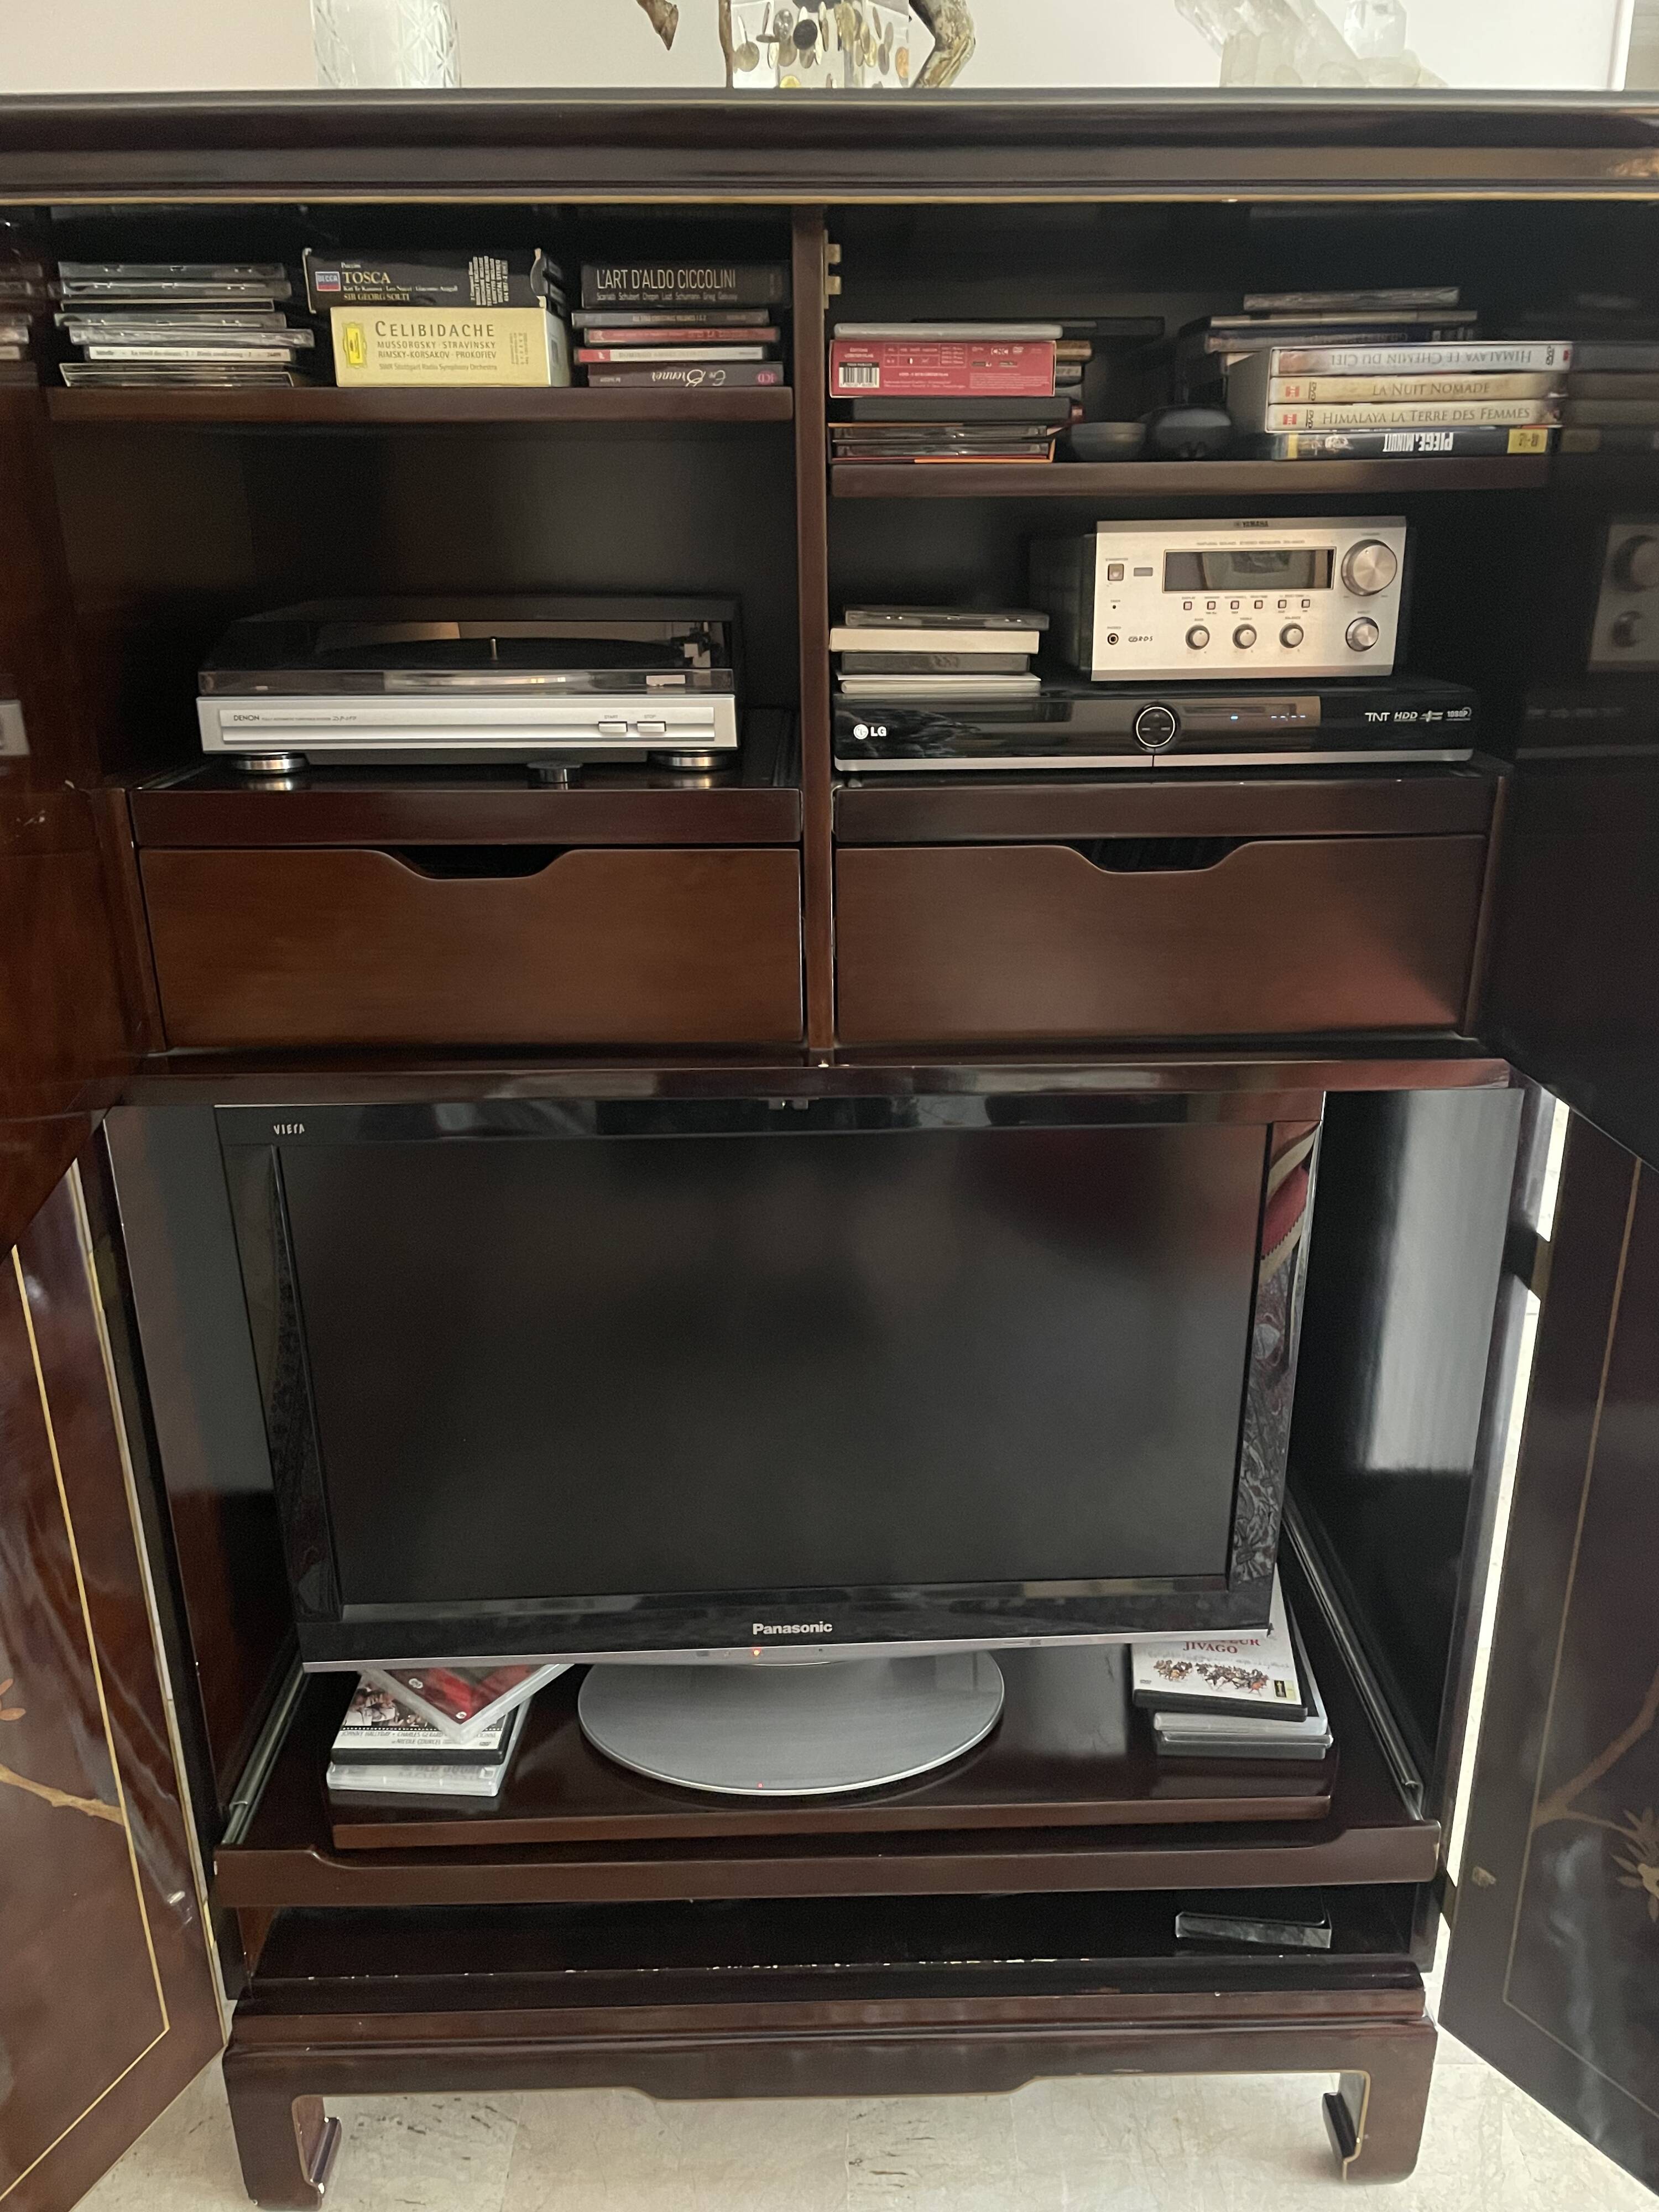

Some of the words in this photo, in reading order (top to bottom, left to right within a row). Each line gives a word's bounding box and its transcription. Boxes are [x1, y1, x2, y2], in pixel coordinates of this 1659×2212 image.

[342, 271, 391, 284] TOSCA
[597, 269, 628, 289] L'ART
[632, 269, 675, 289] D'ALDO
[677, 269, 736, 289] CICCOLINI
[343, 293, 357, 301] SIR
[357, 293, 386, 301] GEORG
[387, 293, 410, 301] SOLTI
[375, 321, 496, 337] CELIBIDACHE
[377, 341, 436, 349] MUSSORGSKY
[443, 341, 497, 349] STRAVINSKY
[378, 351, 450, 359] RIMSKY-KORSAKOV
[456, 350, 497, 359] PROKOFIEV
[1332, 354, 1358, 366] CIEL
[1363, 354, 1381, 364] DU
[1387, 352, 1443, 365] CHEMIN
[1447, 351, 1460, 363] LE
[1466, 350, 1532, 363] HIMALAYA
[394, 363, 421, 372] Stuttgart
[1308, 382, 1317, 401] DVD
[1373, 385, 1386, 396] LA
[1392, 383, 1427, 396] NUIT
[1430, 383, 1490, 395] NOMADE
[1306, 409, 1314, 429] DVD
[1323, 412, 1386, 424] HIMALAYA
[1391, 412, 1405, 422] LA
[1411, 410, 1449, 422] TERRE
[1452, 410, 1479, 421] DES
[1480, 408, 1530, 420] FEMMES
[1383, 433, 1415, 452] MINUIT
[1365, 712, 1391, 722] TNT
[1394, 711, 1418, 720] HDD
[870, 726, 887, 737] LG
[753, 1620, 833, 1635] Panasonic
[1182, 1641, 1238, 1653] JIVAGO
